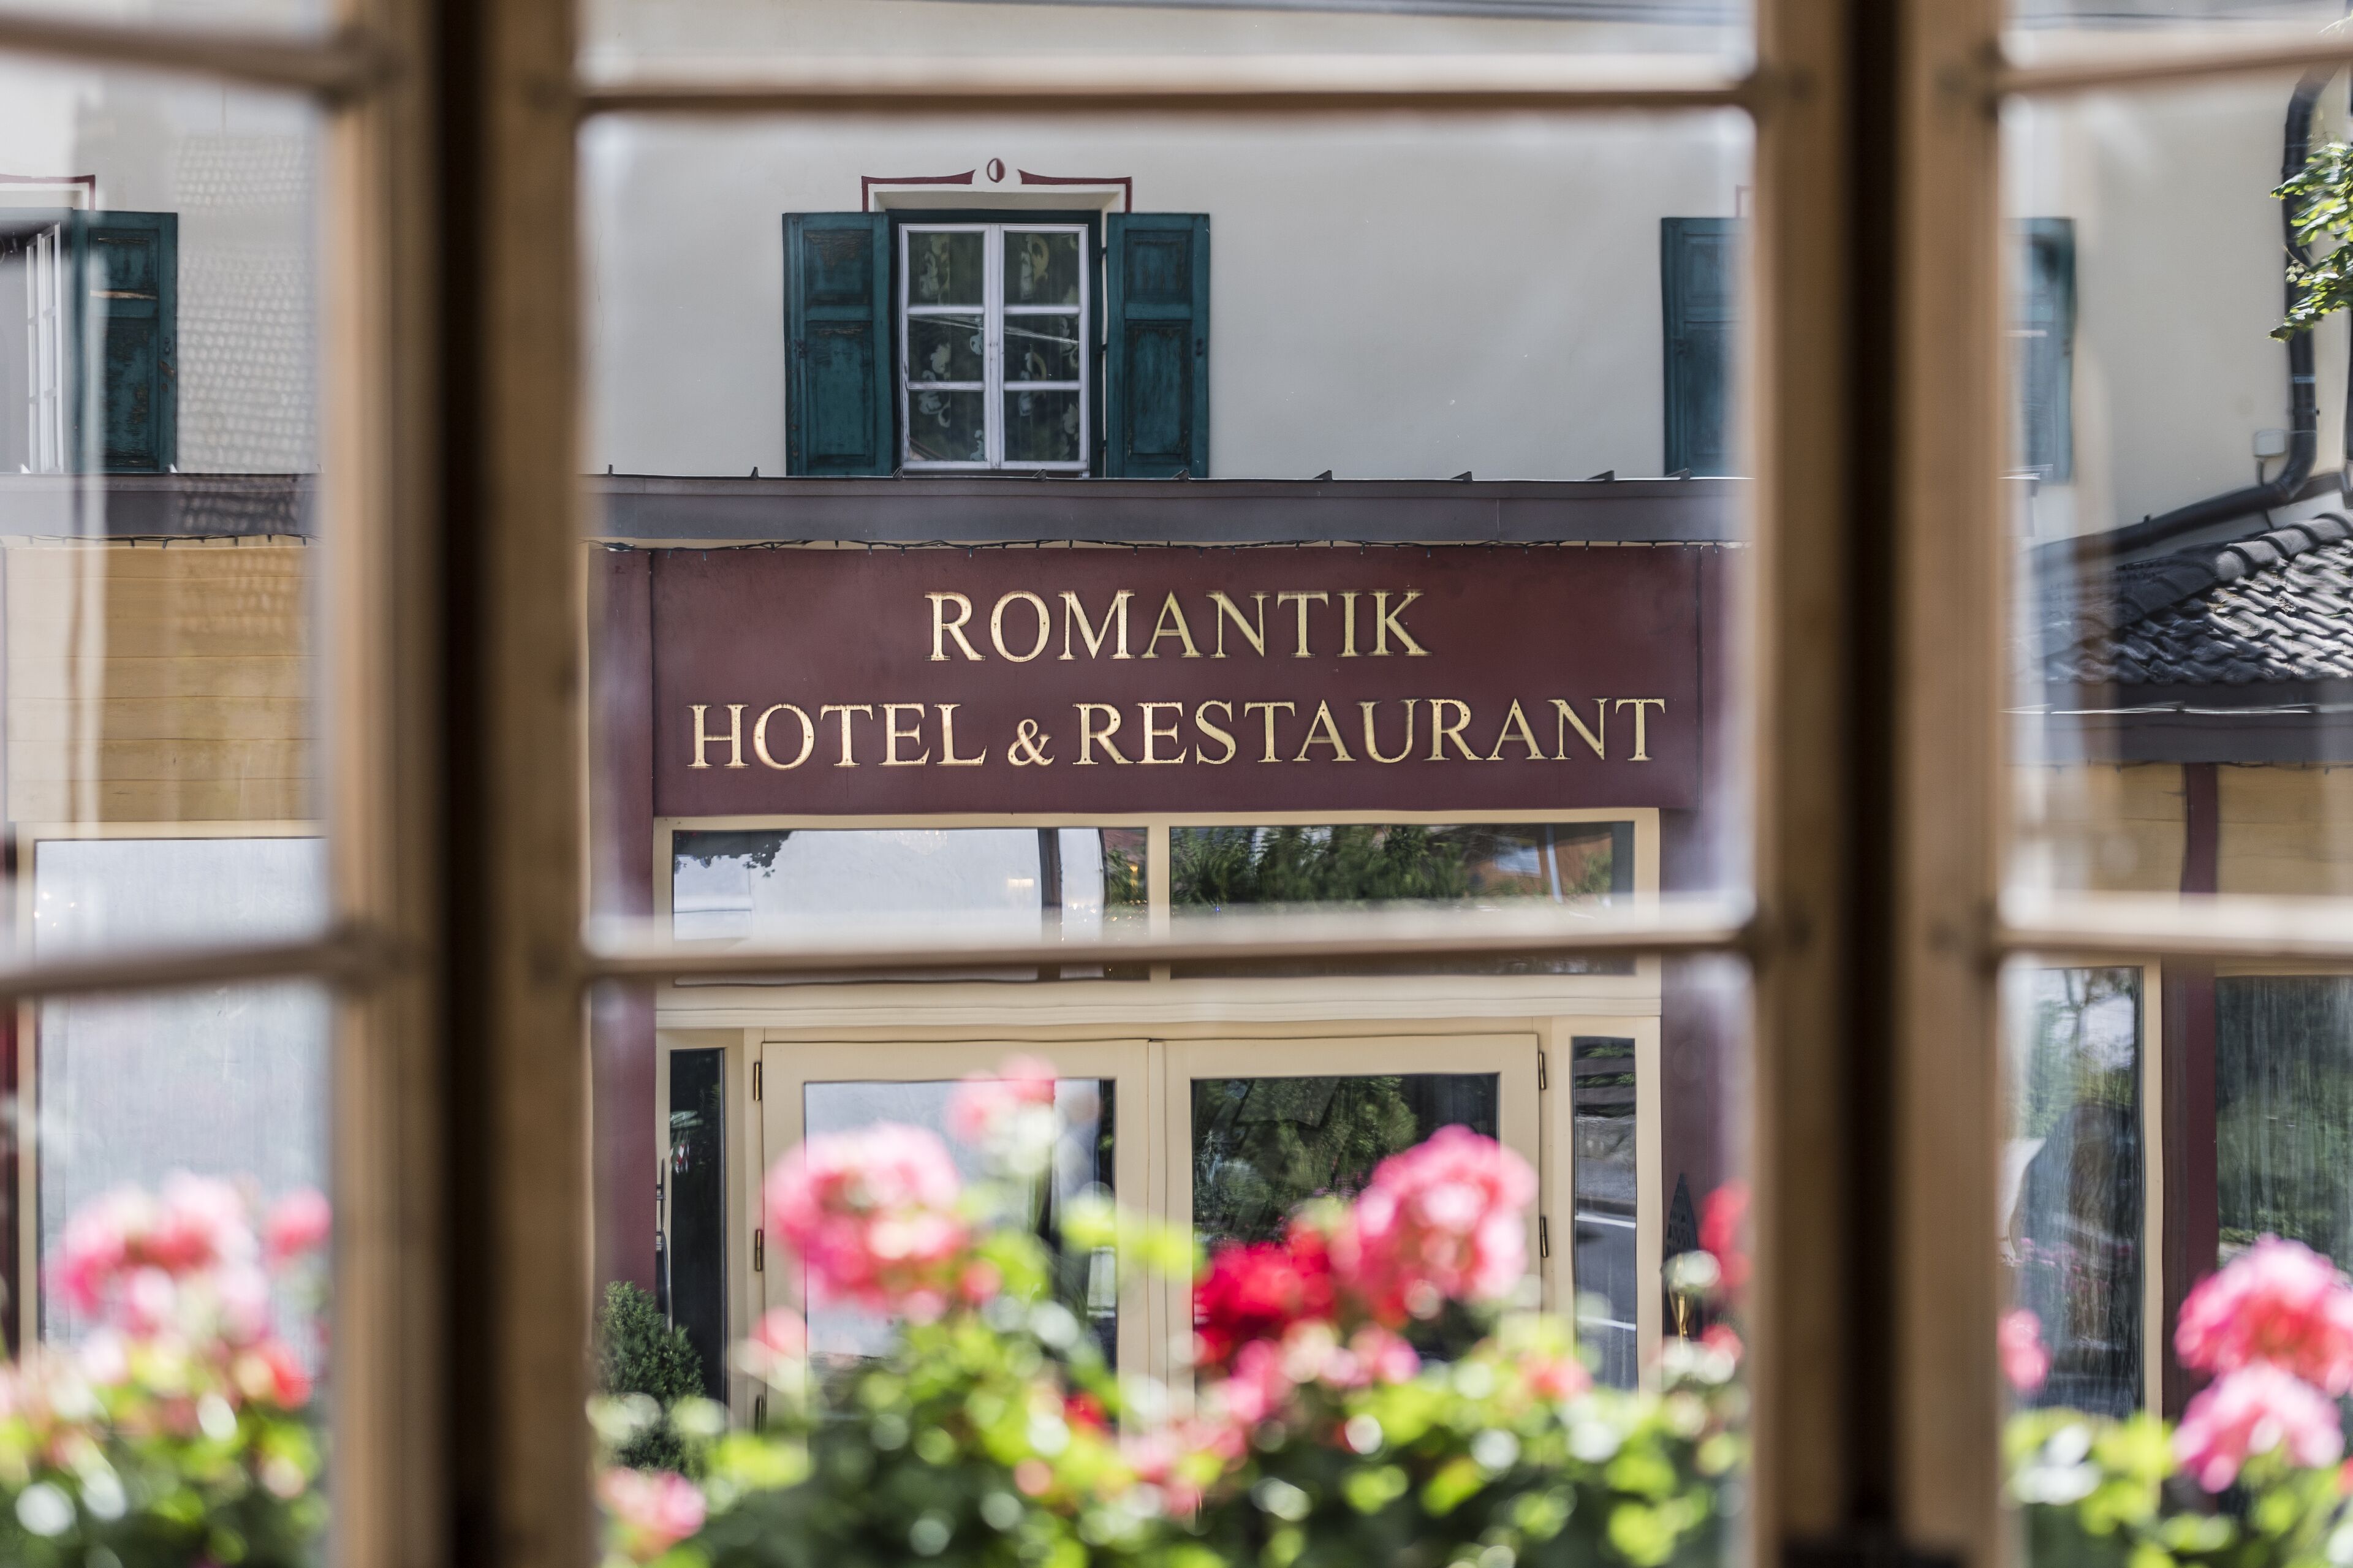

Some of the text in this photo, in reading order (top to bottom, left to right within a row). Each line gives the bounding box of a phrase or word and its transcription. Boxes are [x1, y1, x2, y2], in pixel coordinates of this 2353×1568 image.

[925, 590, 1430, 662] ROMANTIK
[688, 699, 1666, 770] HOTEL & RESTAURANT
